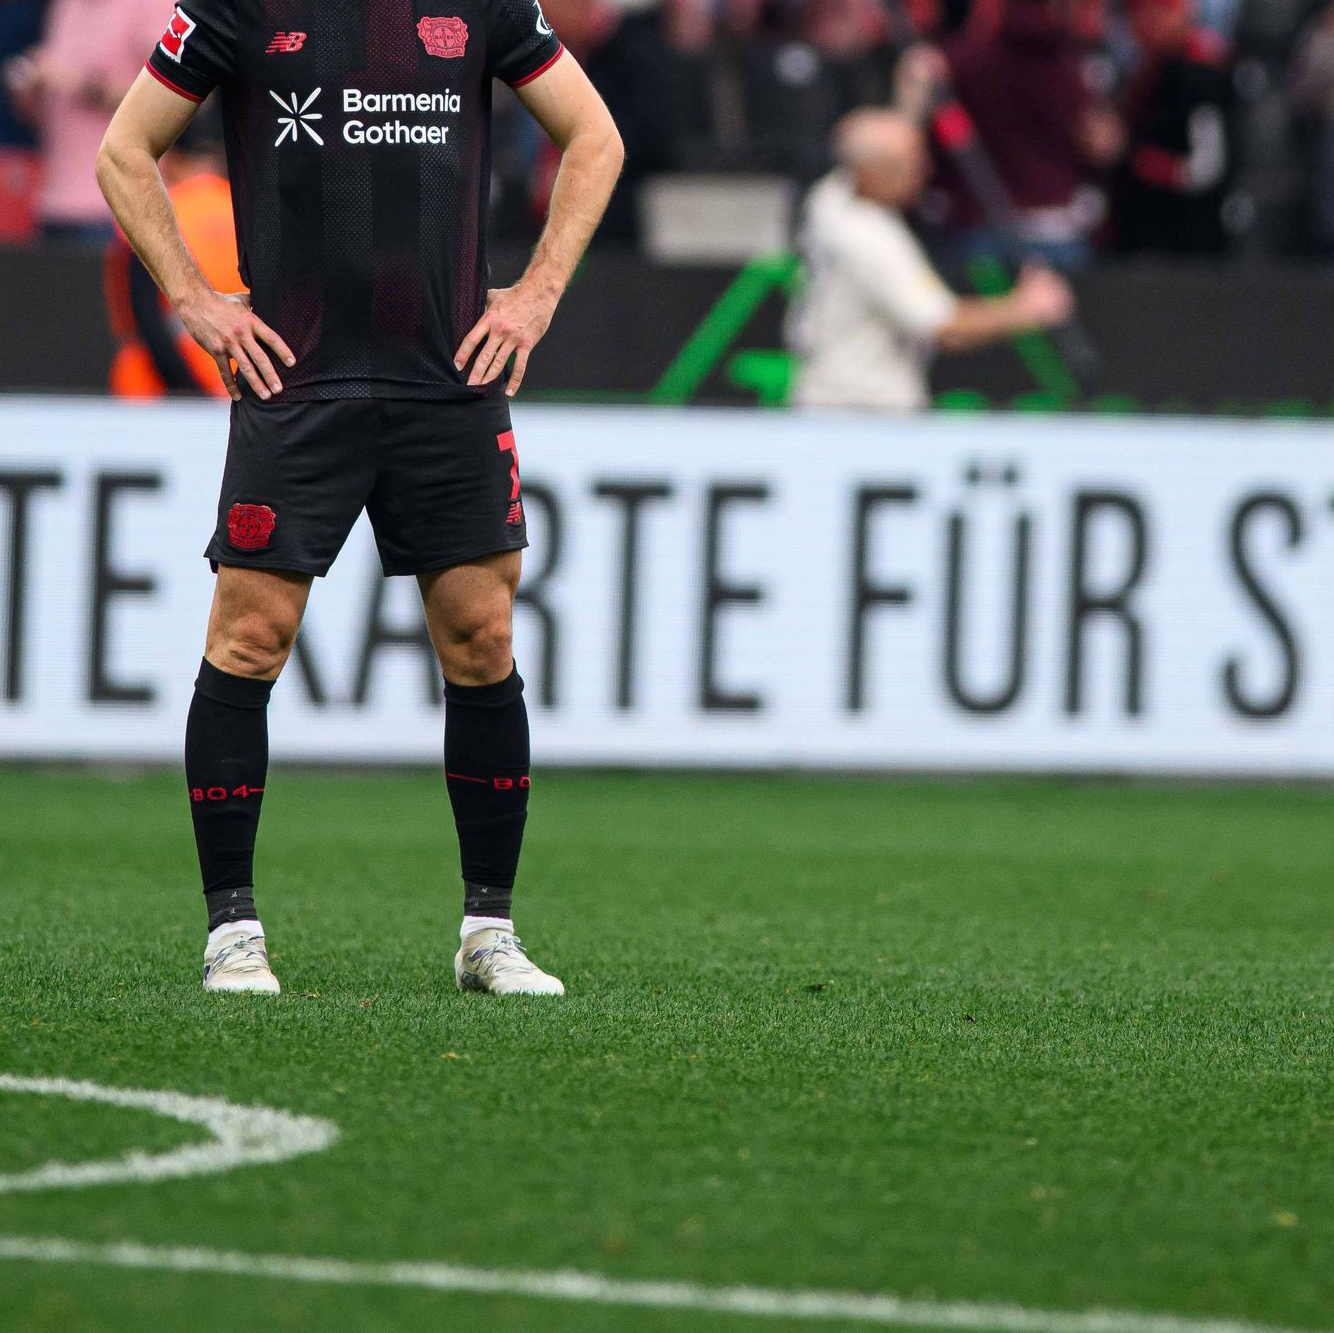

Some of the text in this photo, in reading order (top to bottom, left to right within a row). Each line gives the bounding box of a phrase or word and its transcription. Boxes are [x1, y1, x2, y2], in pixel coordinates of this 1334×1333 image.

[342, 88, 461, 113] Barmenia
[342, 119, 450, 145] Gothaer
[845, 462, 1151, 718] FÜR
